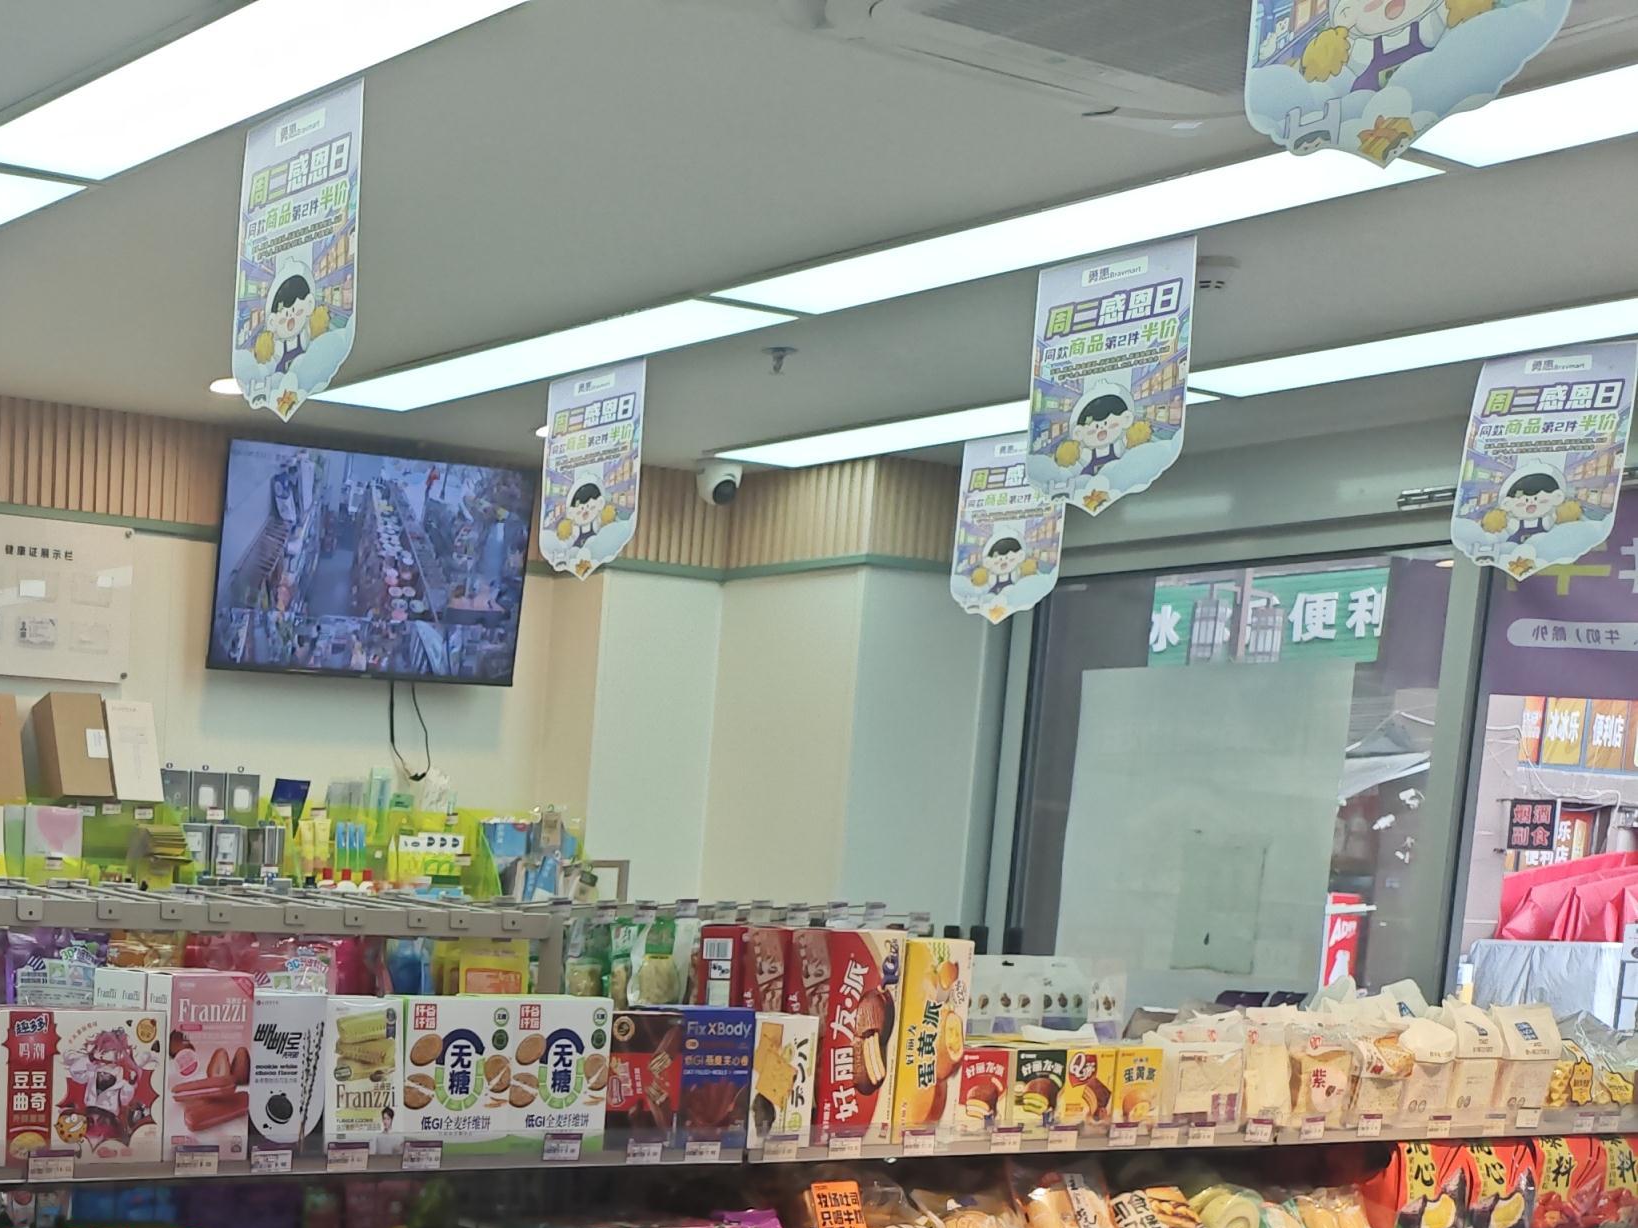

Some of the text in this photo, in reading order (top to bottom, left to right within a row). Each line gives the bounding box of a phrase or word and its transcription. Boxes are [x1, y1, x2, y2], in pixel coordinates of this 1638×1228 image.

[249, 133, 351, 212] 周二感恩日
[1045, 278, 1183, 340] 周二感恩日
[1044, 318, 1179, 362] 同款商品第2件半价
[1482, 379, 1625, 417] 周二感恩日
[552, 392, 636, 439] 周二感恩日
[1479, 413, 1618, 437] 同款商品第2件半价
[5, 544, 74, 561] 健康证展示栏
[1547, 711, 1580, 743] 冰冰乐
[1593, 713, 1625, 748] 便利店
[177, 998, 248, 1025] Franzzi
[917, 999, 944, 1089] 蛋黄派
[13, 1071, 47, 1090] 豆豆
[448, 1043, 472, 1096] 无糖
[552, 1042, 573, 1094] 无糖
[13, 1093, 46, 1112] 曲奇
[336, 1085, 397, 1109] Franzzi
[421, 1114, 491, 1131] 低GI全麦纤维饼
[525, 1113, 590, 1129] 低GI全麦纤维饼
[816, 1191, 860, 1208] 牧场吐司
[821, 1209, 865, 1226] 只喝牛奶
